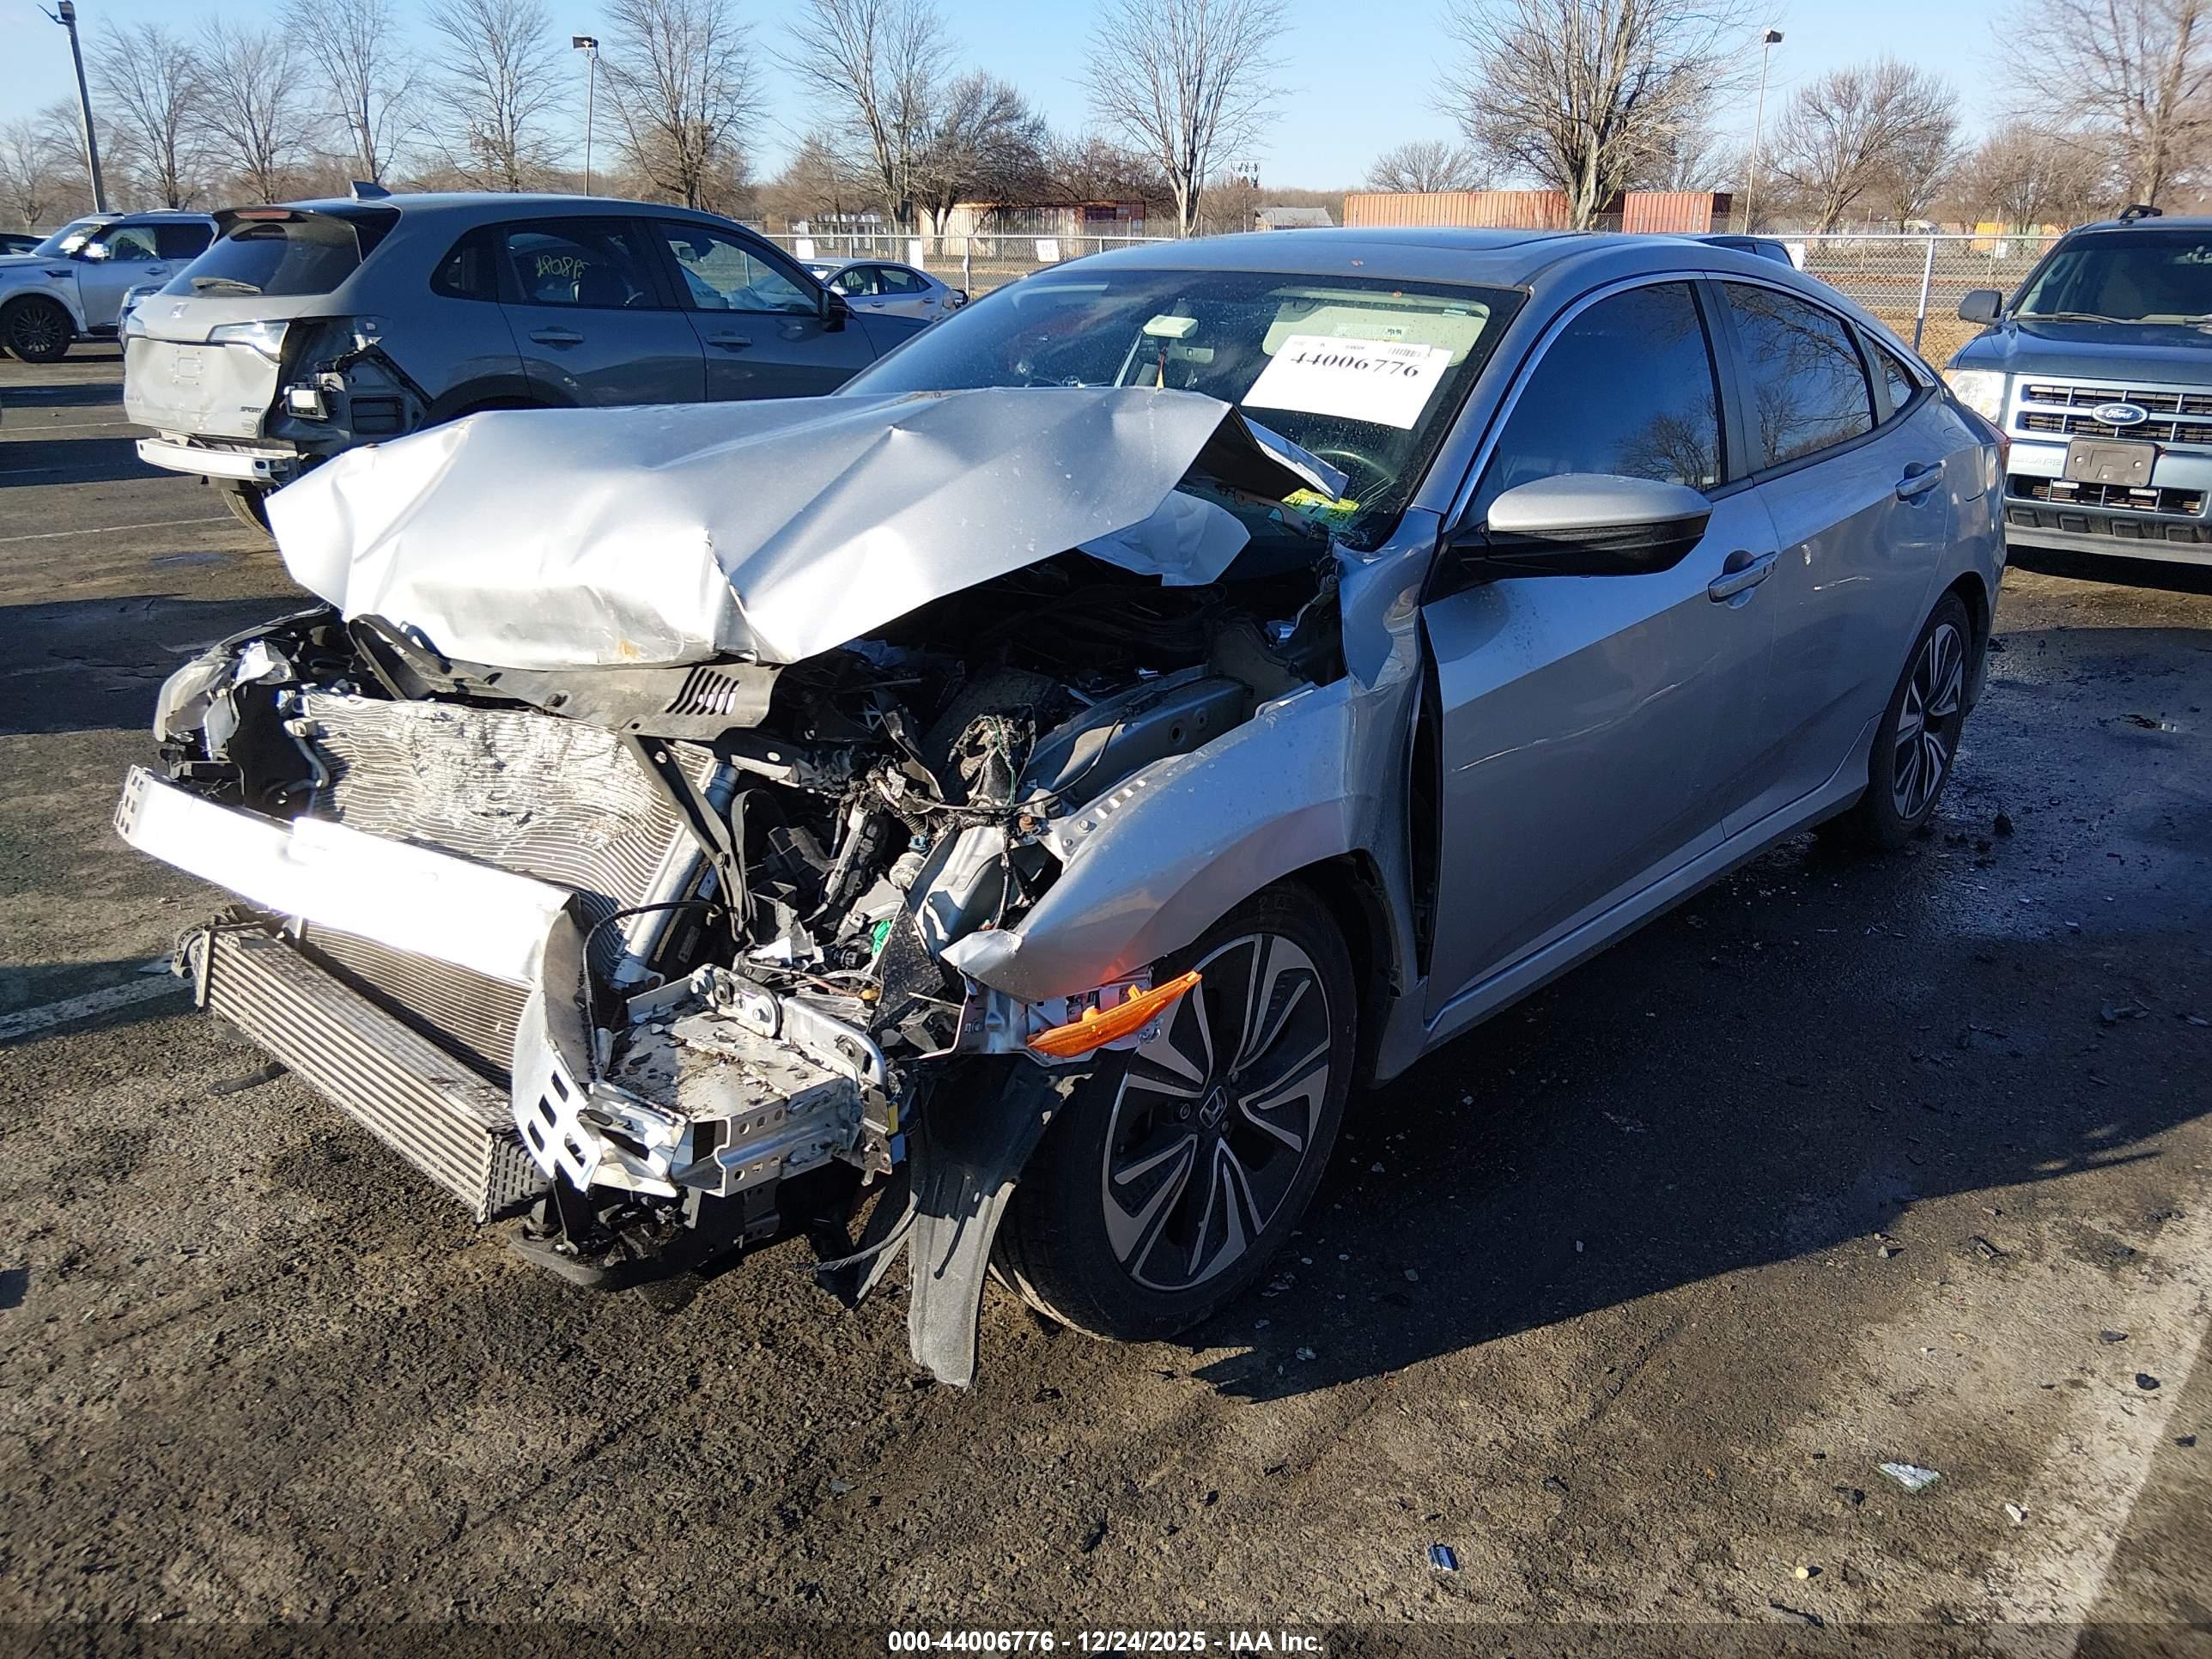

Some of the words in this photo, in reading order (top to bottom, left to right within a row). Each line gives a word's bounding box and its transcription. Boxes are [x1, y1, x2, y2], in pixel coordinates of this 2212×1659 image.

[1291, 351, 1421, 378] 44006776
[240, 405, 264, 414] SPORT
[2106, 408, 2134, 420] Ford
[1287, 495, 1303, 507] 20
[1309, 501, 1322, 514] 7
